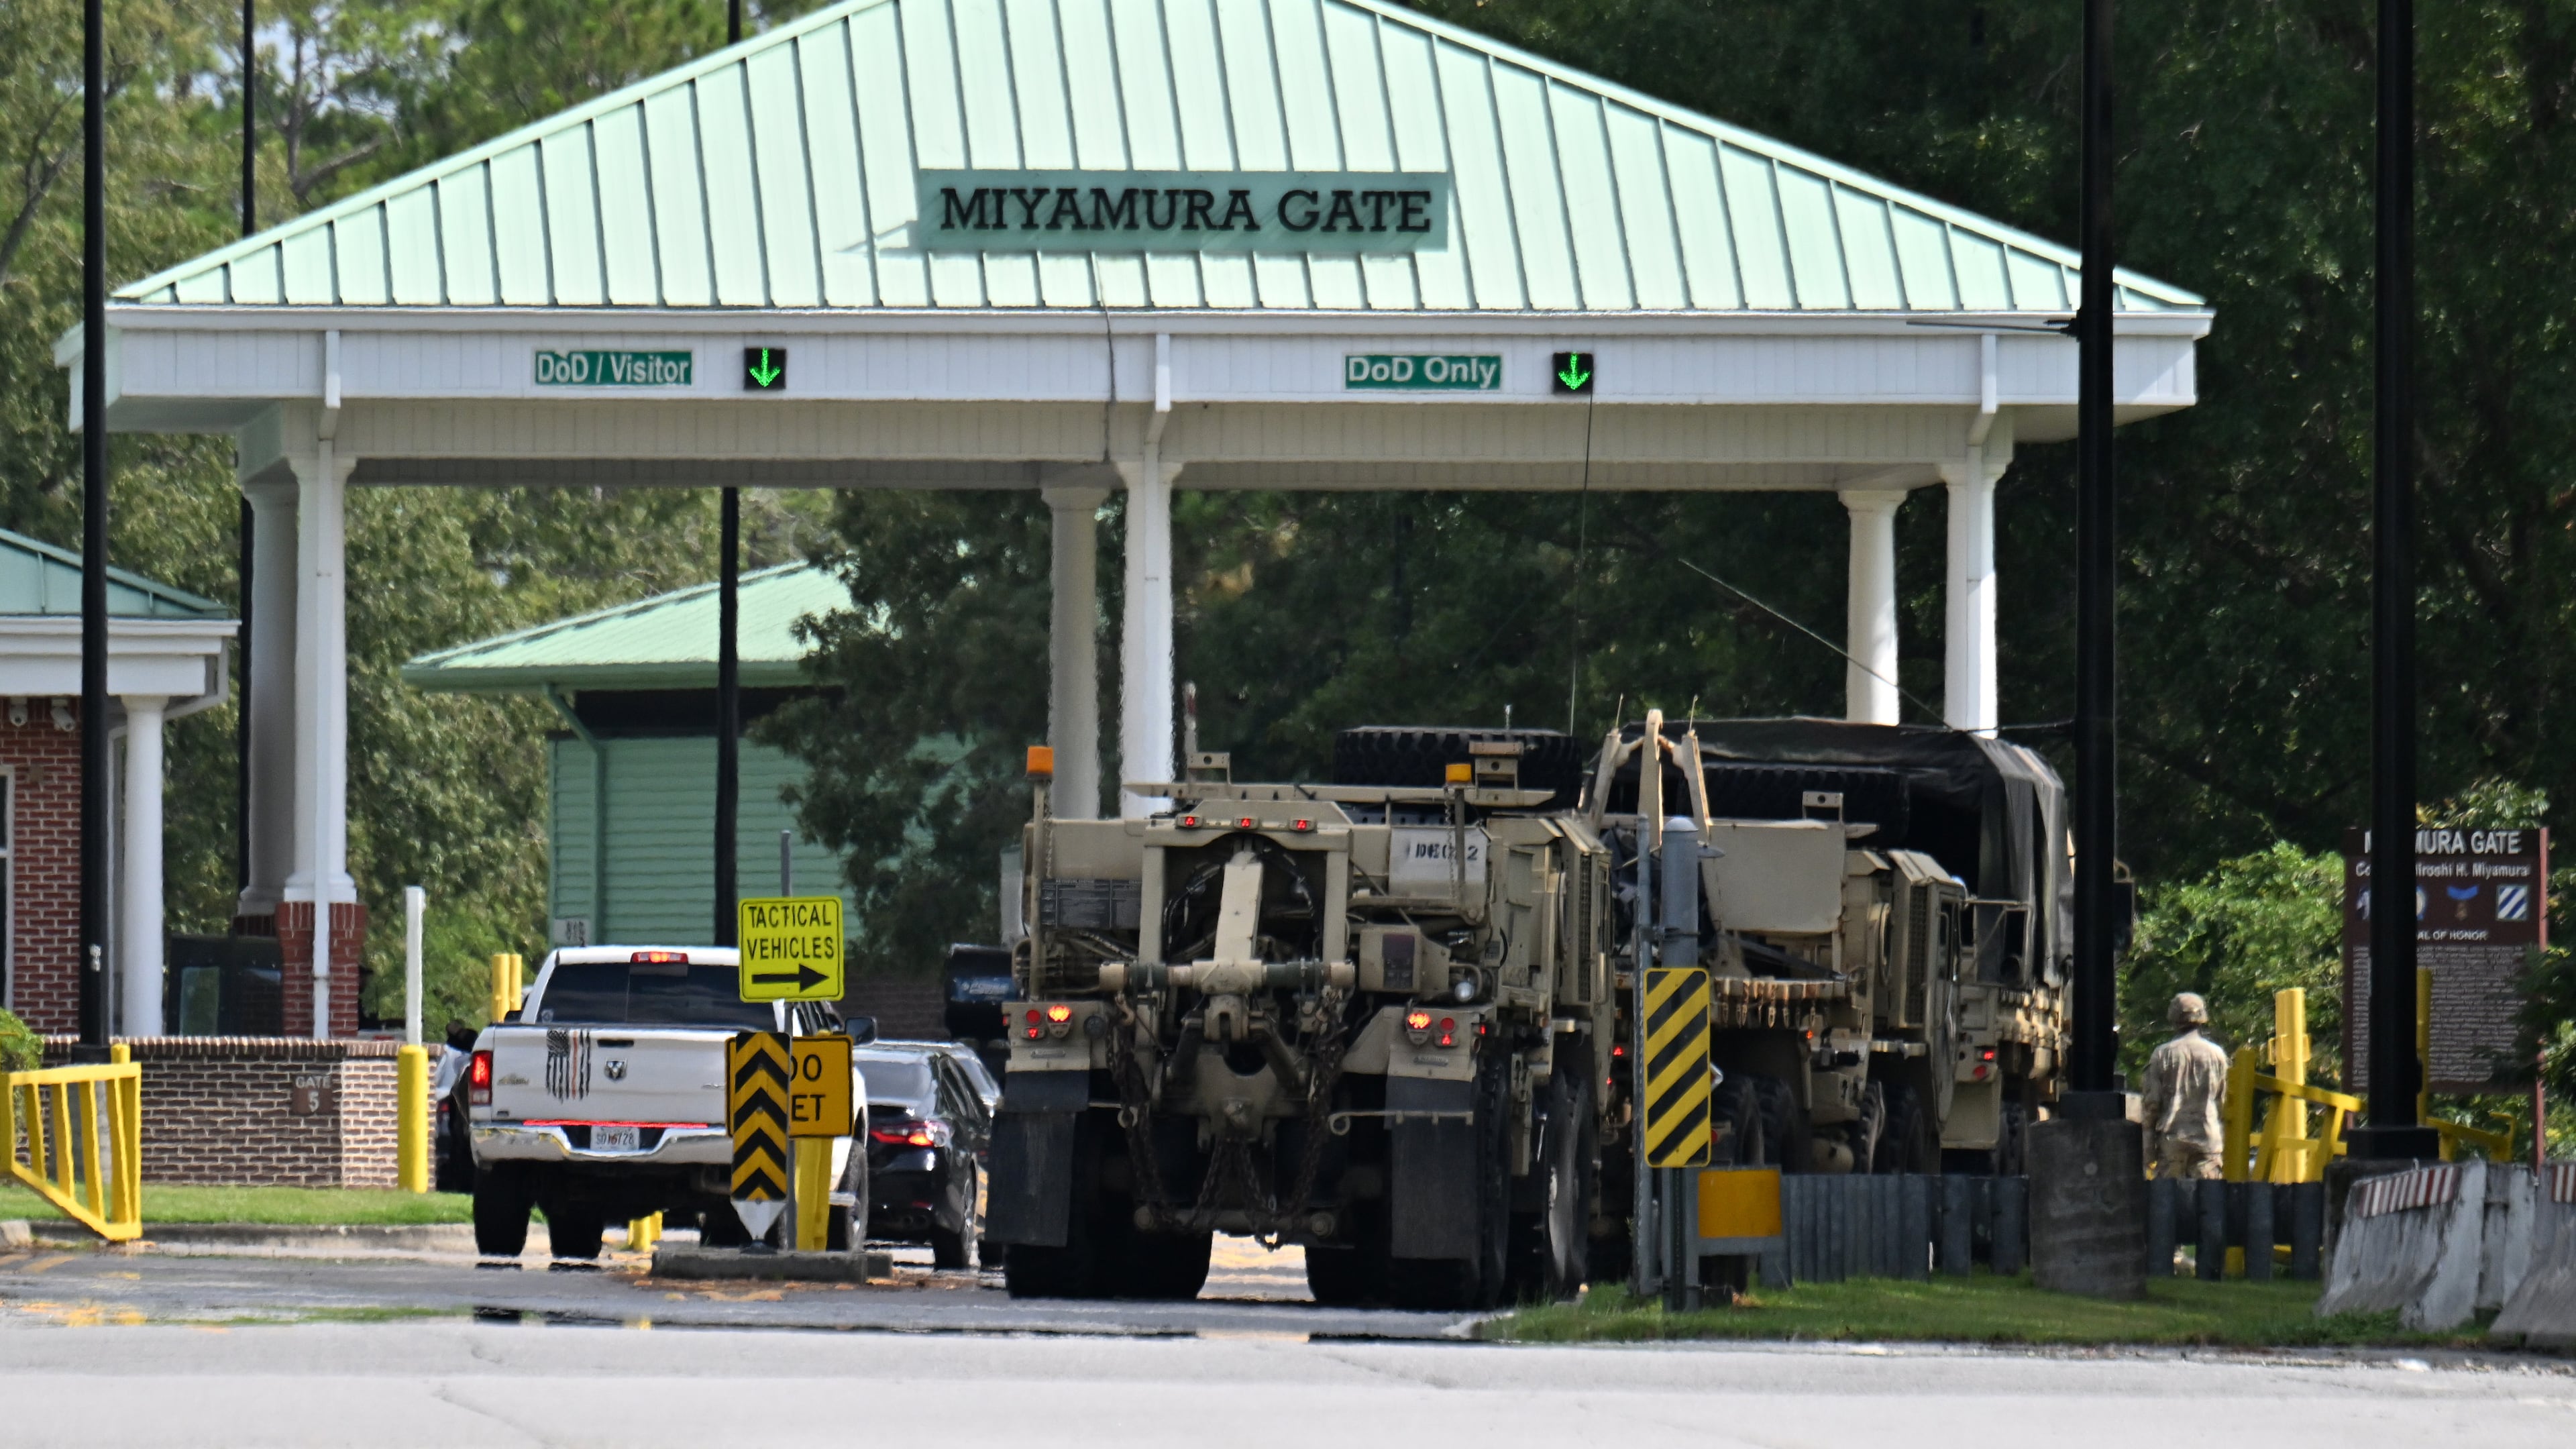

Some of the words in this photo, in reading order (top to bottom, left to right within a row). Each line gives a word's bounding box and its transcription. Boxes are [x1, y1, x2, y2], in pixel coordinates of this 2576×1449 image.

[940, 187, 1261, 231] MIYAMURA
[1277, 189, 1432, 233] GATE
[537, 354, 588, 382] DoD
[596, 354, 603, 383] /
[610, 354, 690, 383] Visitor
[1348, 357, 1413, 382] DoD
[1424, 356, 1497, 389] Only
[2471, 830, 2522, 854] GATE
[2472, 862, 2531, 880] Miyamura
[748, 904, 832, 929] TACTICAL
[2433, 930, 2447, 940] OF
[2450, 930, 2489, 941] HONOR
[747, 936, 835, 961] VEHICLES
[296, 1075, 331, 1089] GATE
[309, 1091, 319, 1112] 5
[792, 1094, 826, 1122] ET
